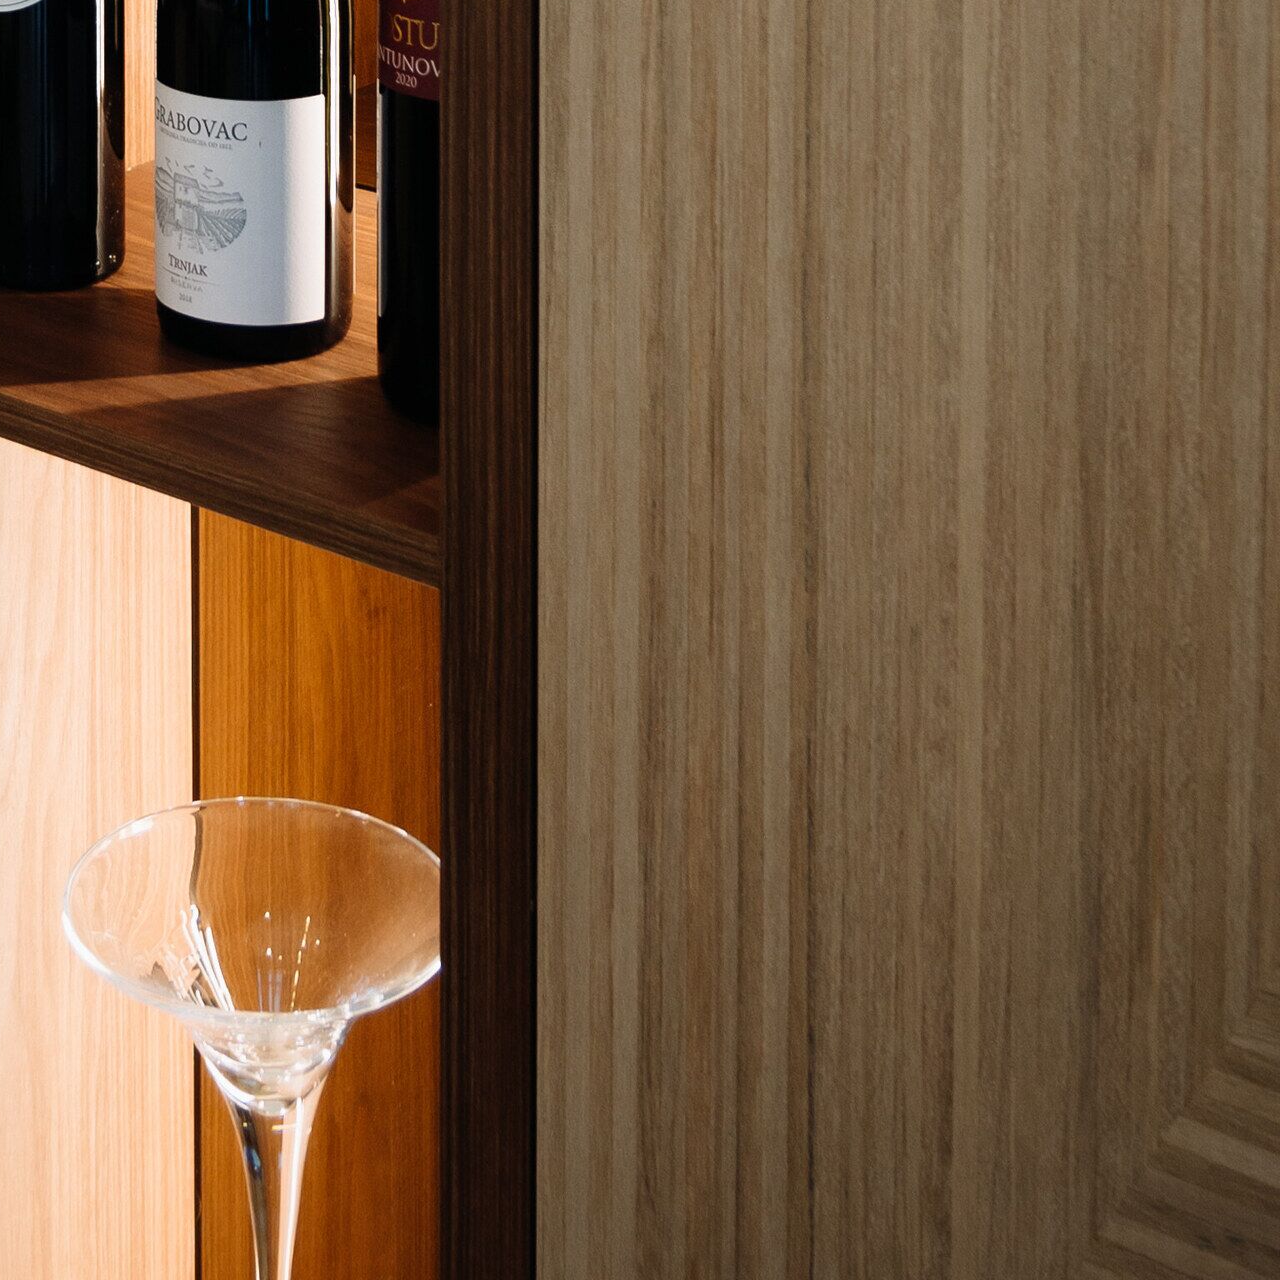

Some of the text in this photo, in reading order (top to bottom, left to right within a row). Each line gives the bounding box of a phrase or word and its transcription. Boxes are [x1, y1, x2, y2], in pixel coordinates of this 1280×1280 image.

[378, 44, 441, 79] NTUNOV
[395, 70, 418, 90] 2020
[167, 251, 209, 279] TRNJAK
